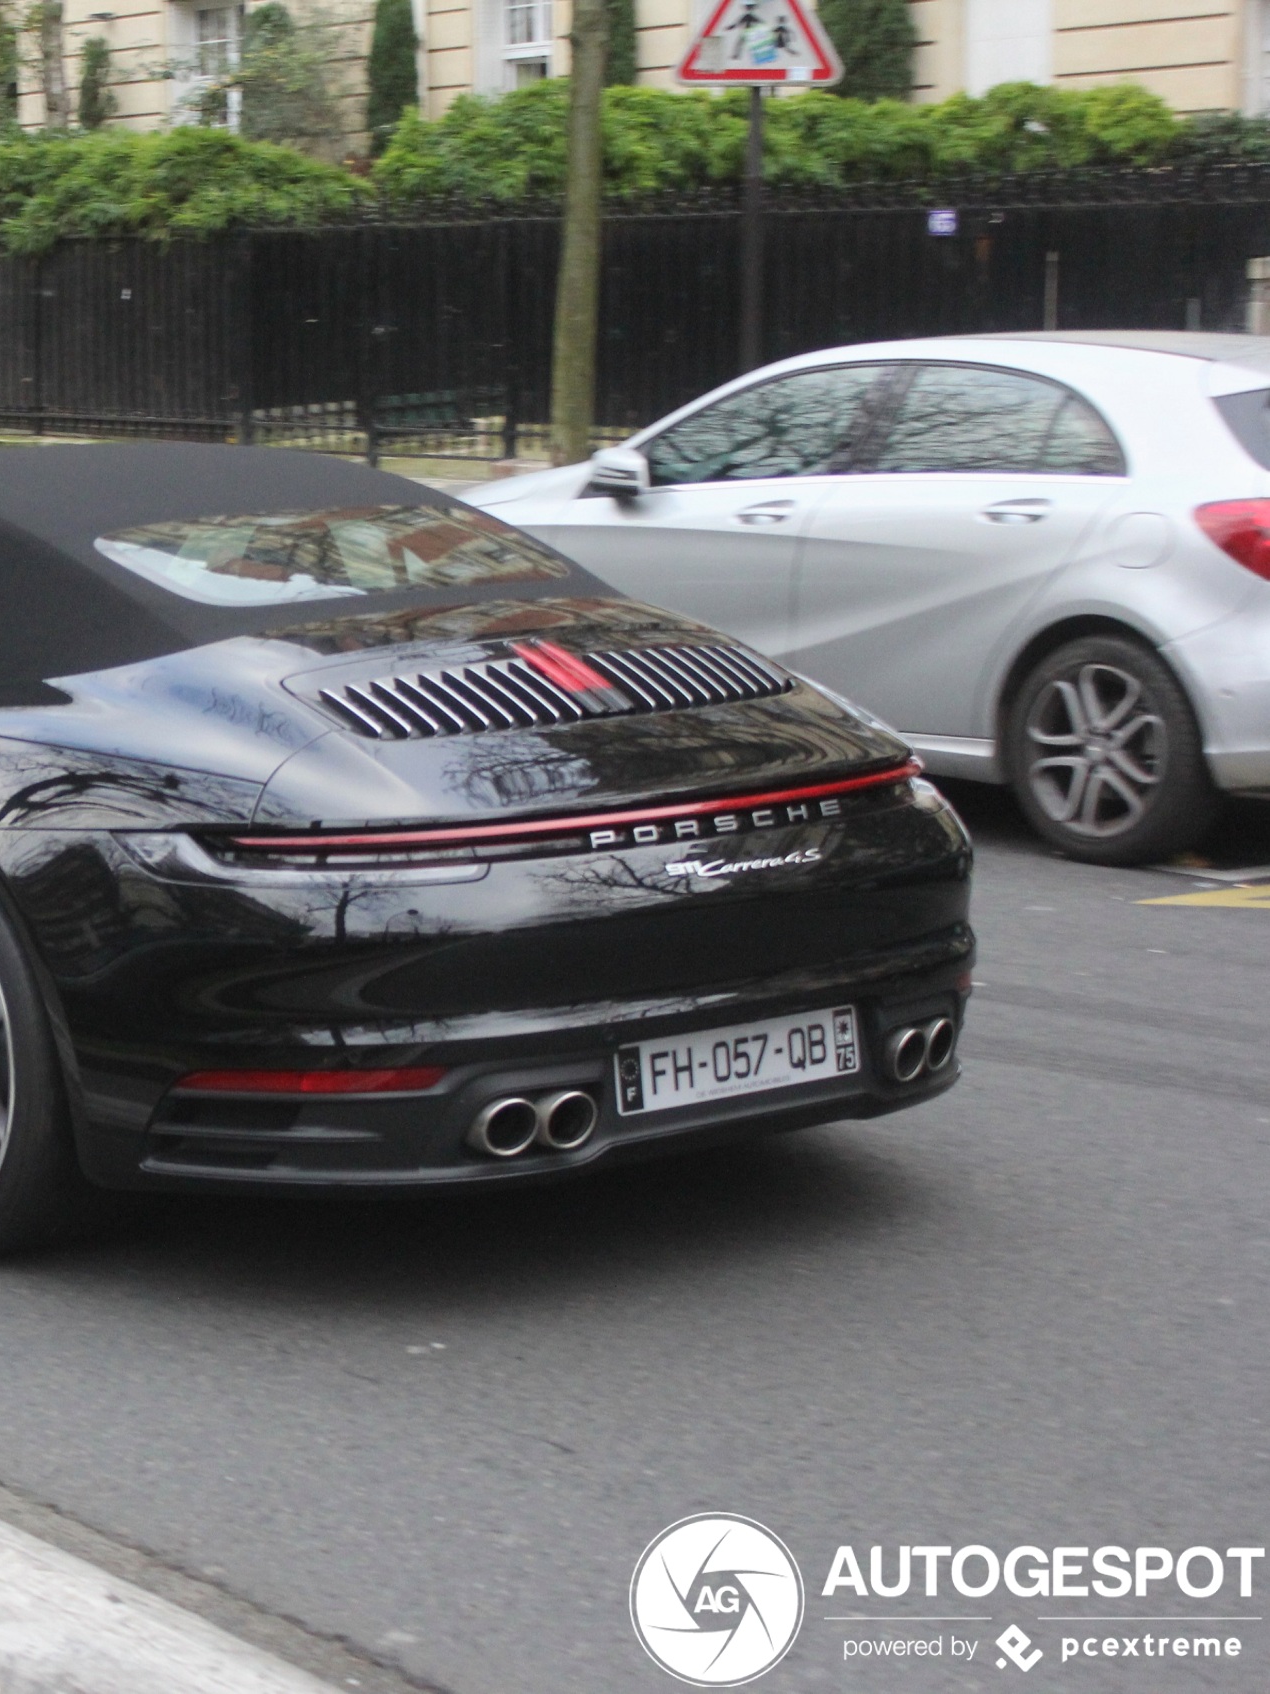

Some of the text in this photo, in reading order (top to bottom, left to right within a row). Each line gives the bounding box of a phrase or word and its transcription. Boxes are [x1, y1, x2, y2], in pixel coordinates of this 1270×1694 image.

[590, 799, 842, 849] PORSCHE
[665, 860, 702, 876] 911
[649, 1023, 827, 1096] FH-057-QB
[836, 1048, 857, 1071] 75
[626, 1086, 636, 1102] F
